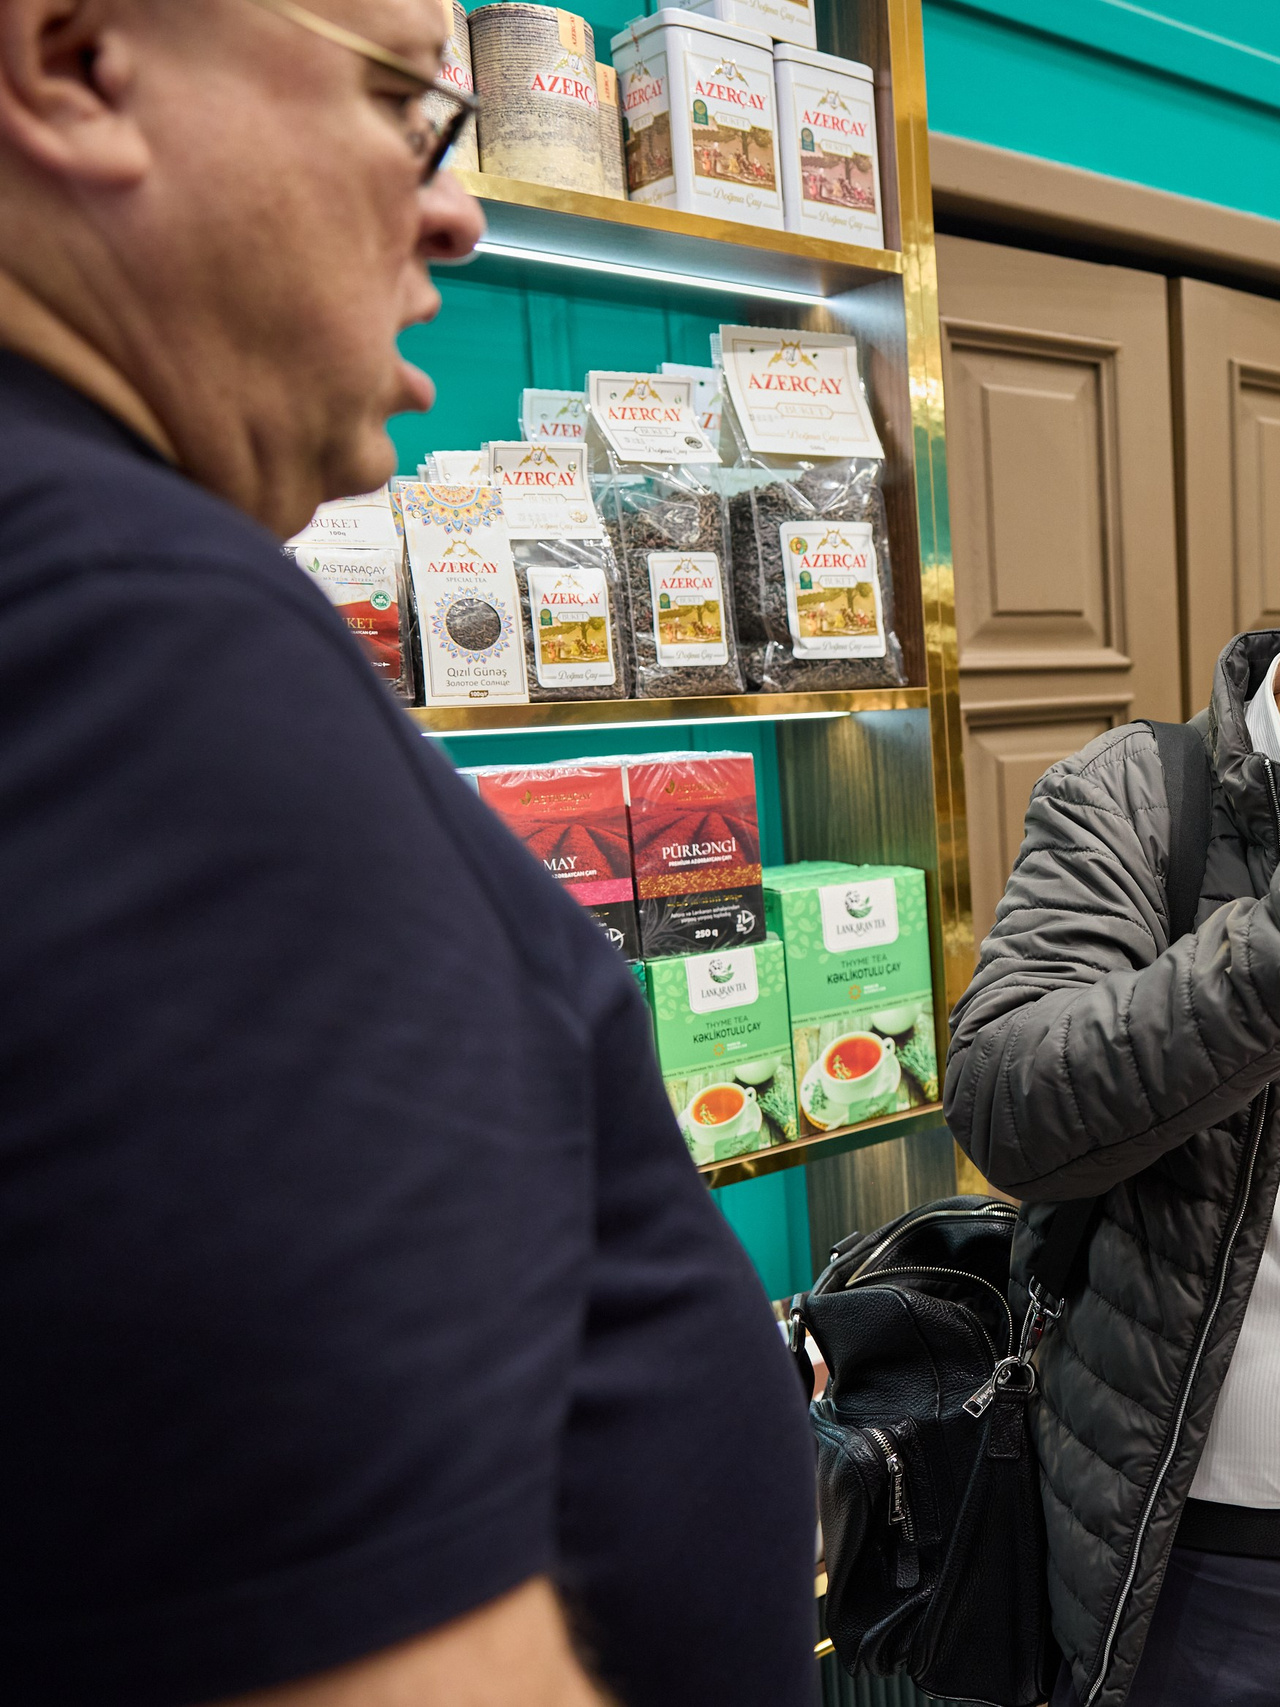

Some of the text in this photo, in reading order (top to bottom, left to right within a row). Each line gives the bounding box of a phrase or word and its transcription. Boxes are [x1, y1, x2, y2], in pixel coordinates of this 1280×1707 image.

[695, 80, 767, 110] AZERÇAY
[802, 110, 868, 138] AZERÇAY
[749, 373, 843, 397] AZERÇAY
[608, 406, 681, 424] AZERÇAY
[502, 471, 577, 489] AZERÇAY
[309, 519, 360, 529] BUKET
[427, 561, 498, 576] AZERÇAY
[801, 554, 868, 570] AZERÇAY
[322, 563, 387, 577] ASTARAÇAY
[660, 577, 715, 590] AZERÇAY
[541, 592, 602, 606] AZERÇAY
[473, 667, 508, 678] Günəş
[558, 670, 584, 682] Doğma
[480, 679, 510, 687] Солнце
[662, 837, 737, 860] PÜRRƏNGİ
[695, 929, 711, 939] 250
[841, 953, 887, 968] THYME TEA
[827, 962, 901, 985] KƏKLİKOTULU ÇAY
[706, 1015, 749, 1029] THYME TEA
[693, 1022, 761, 1043] KƏKLİKOTULU ÇAY
